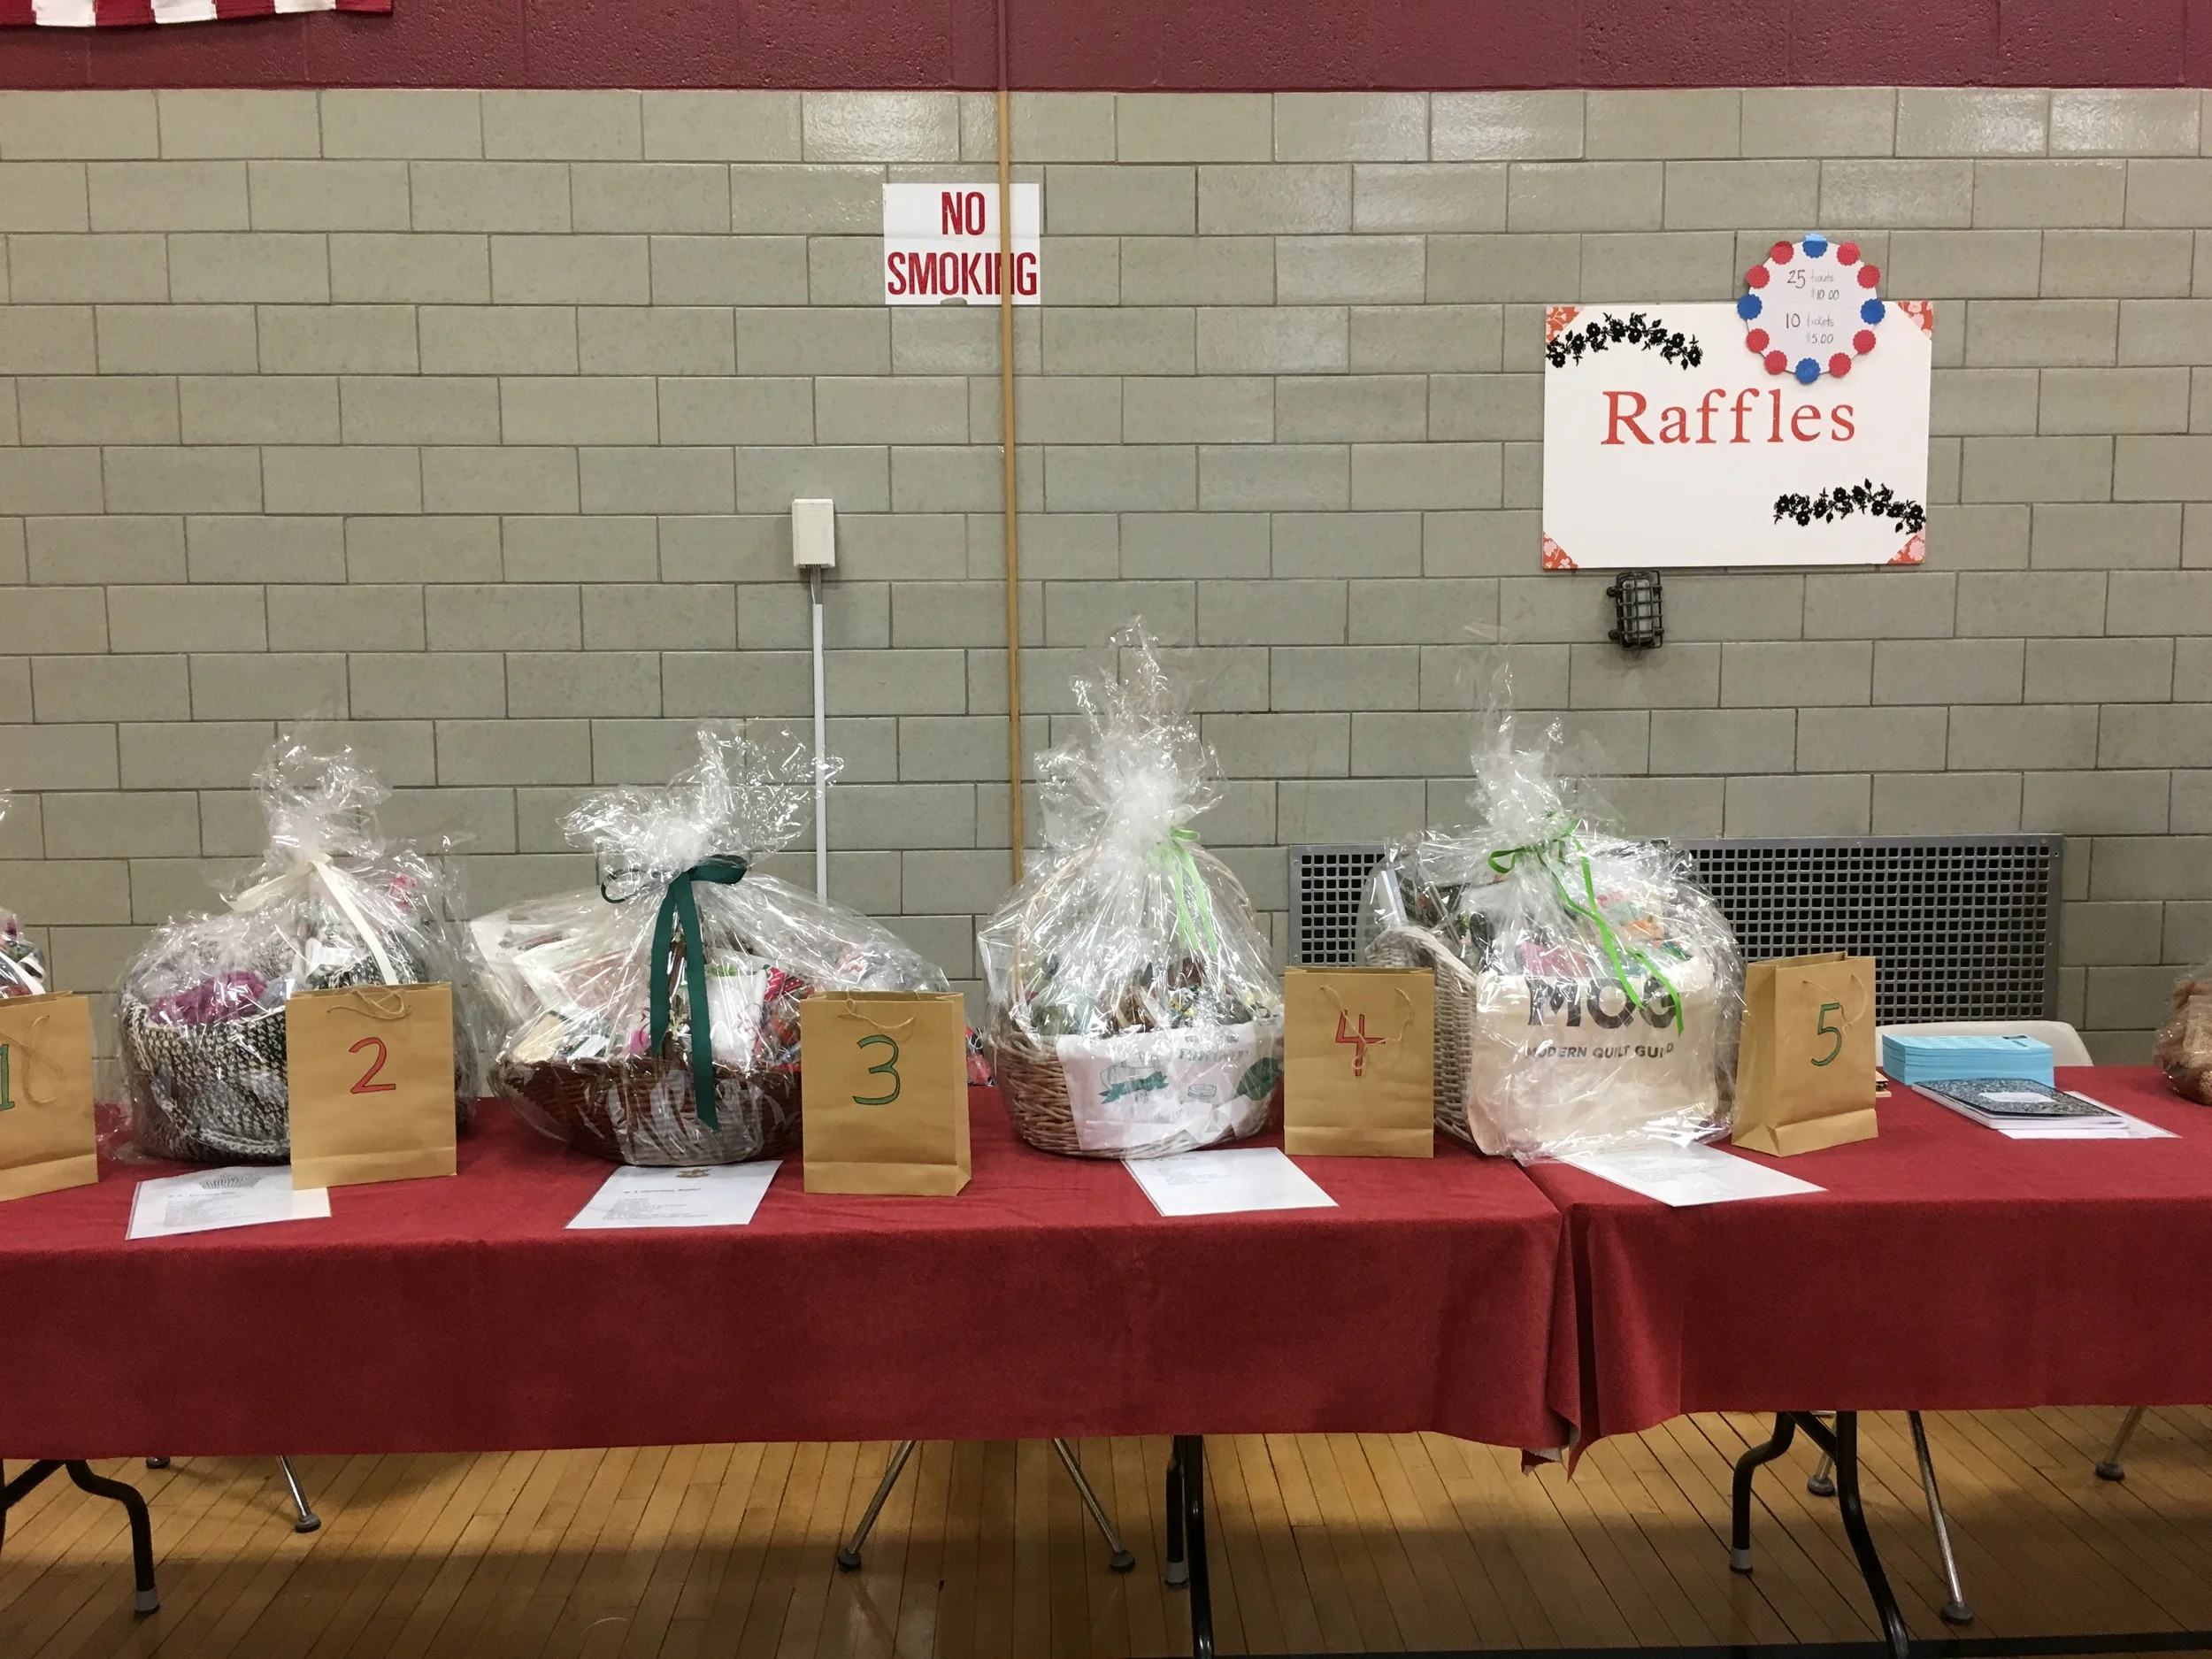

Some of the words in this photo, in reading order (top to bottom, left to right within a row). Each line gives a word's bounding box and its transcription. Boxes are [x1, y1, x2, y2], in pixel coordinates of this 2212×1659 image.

[941, 191, 986, 235] NO
[887, 252, 1037, 296] SMOKING
[1786, 269, 1806, 288] 25
[1786, 312, 1801, 328] 10
[1807, 312, 1835, 327] tickets
[1601, 388, 1855, 444] Raffles
[1335, 1009, 1386, 1077] 4
[1526, 1046, 1587, 1058] MODERN
[1593, 1045, 1630, 1058] QUILT
[1634, 1042, 1674, 1059] GUID
[1810, 1002, 1842, 1067] 5
[0, 1043, 15, 1111] 1
[349, 1037, 396, 1094] 2
[852, 1033, 901, 1106] 3
